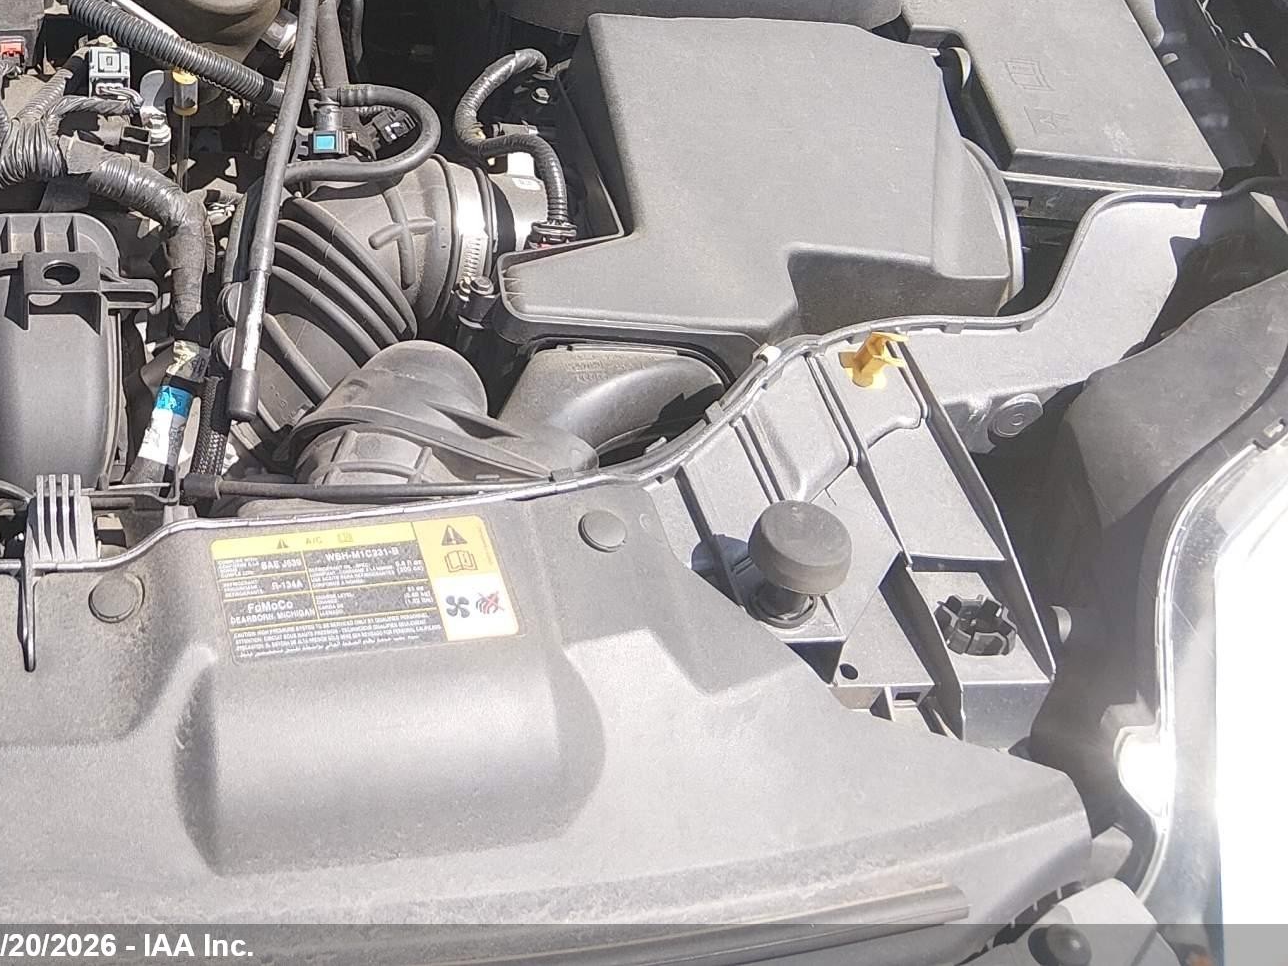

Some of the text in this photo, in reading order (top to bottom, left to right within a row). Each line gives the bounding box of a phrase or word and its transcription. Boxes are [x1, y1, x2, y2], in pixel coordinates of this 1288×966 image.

[272, 580, 304, 591] R-134A
[247, 600, 293, 614] FoMoCo
[276, 608, 316, 620] MICHIGAN
